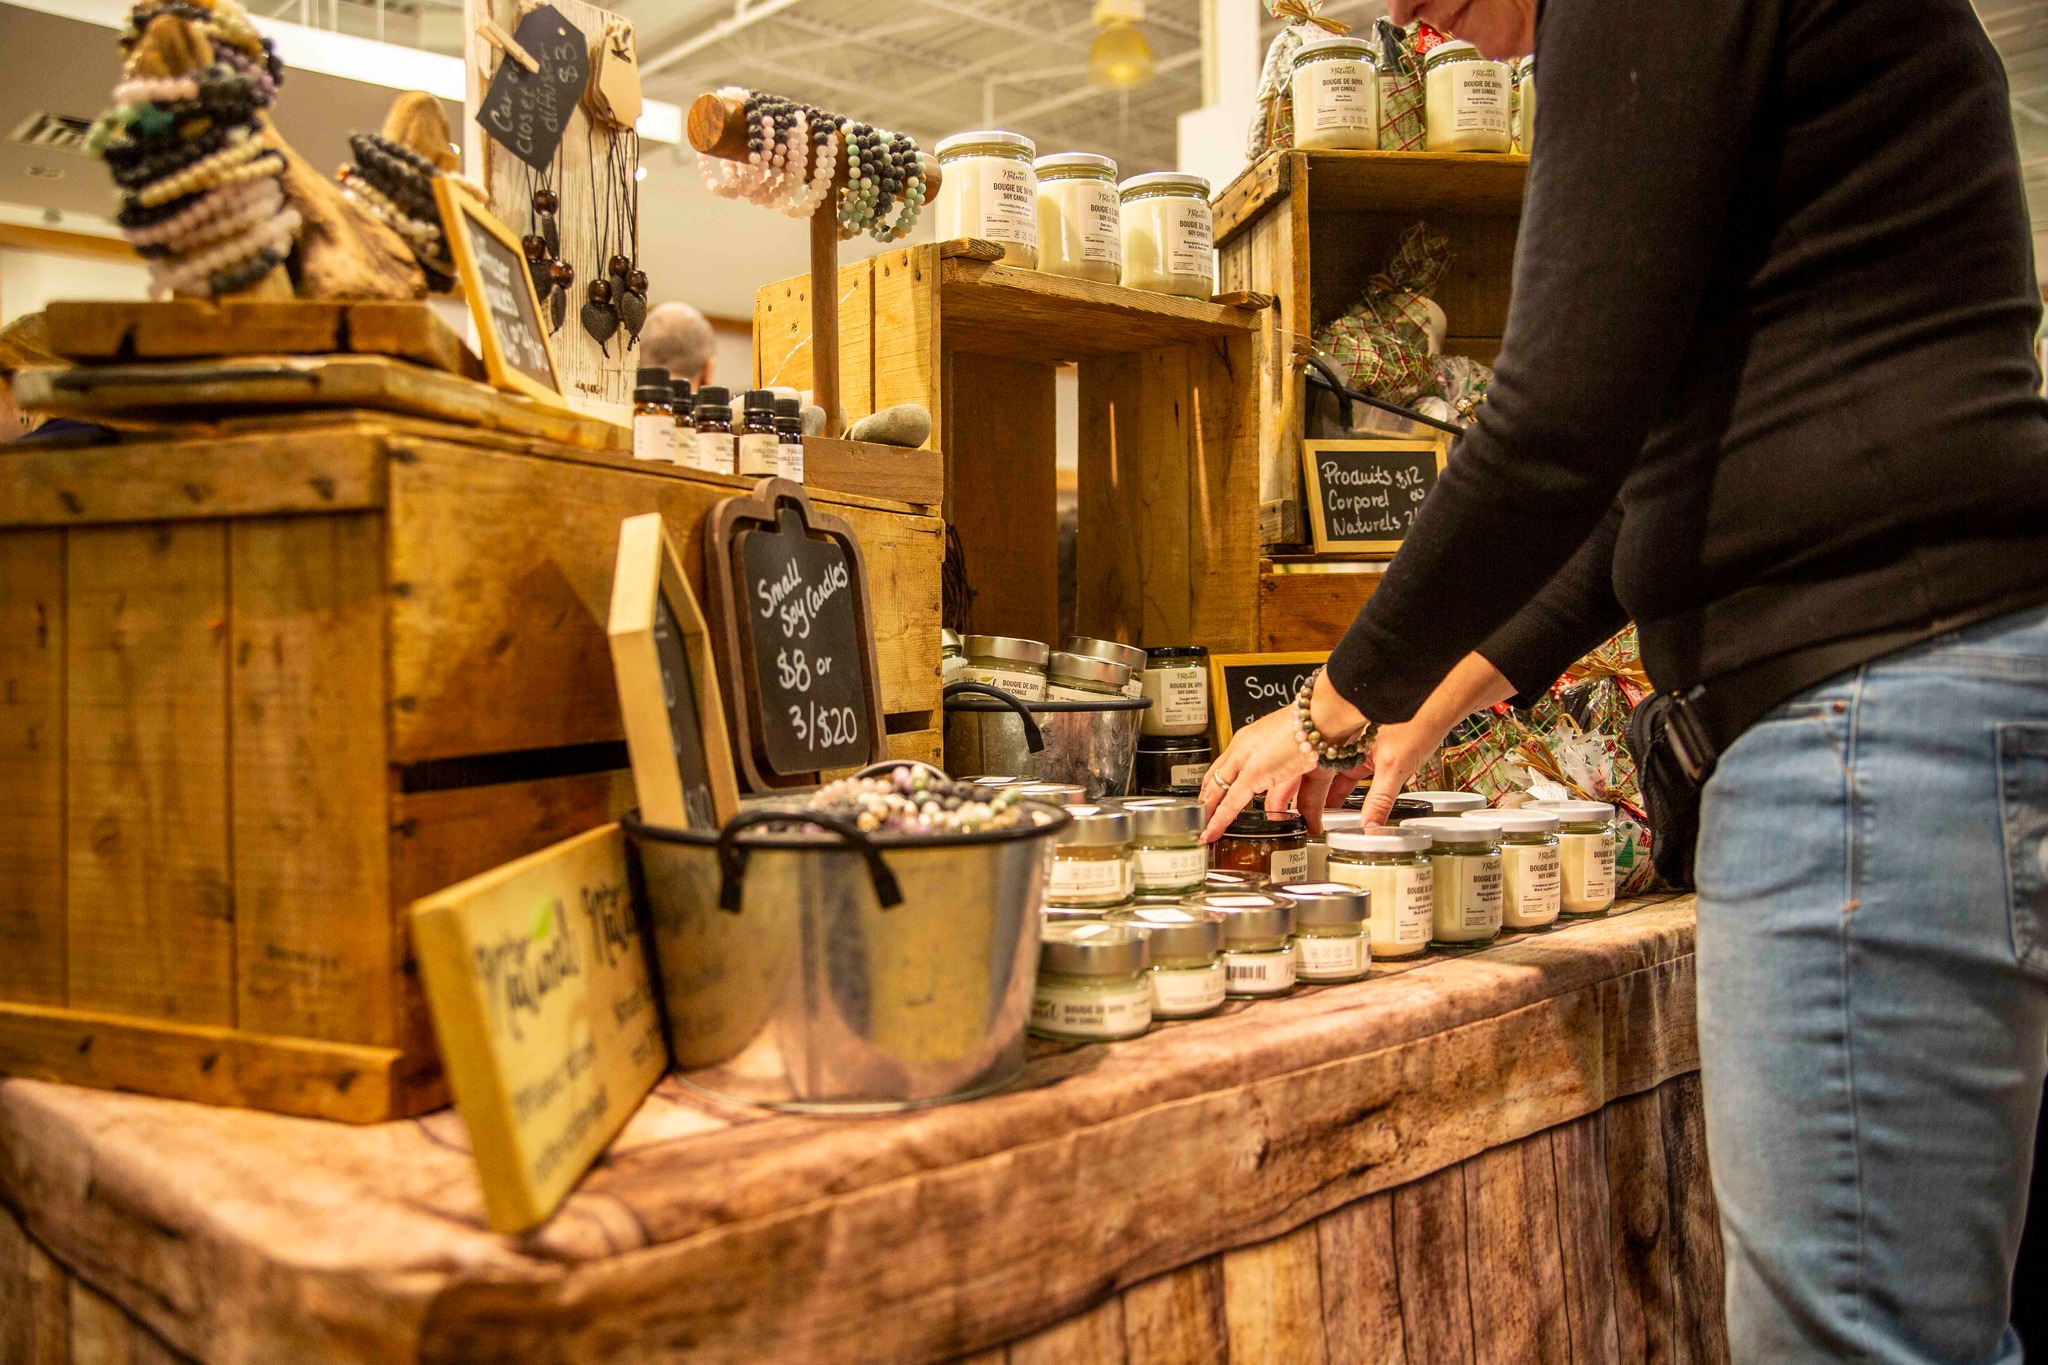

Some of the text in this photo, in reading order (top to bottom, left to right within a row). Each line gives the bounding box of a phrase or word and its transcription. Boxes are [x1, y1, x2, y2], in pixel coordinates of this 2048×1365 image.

[1323, 78, 1342, 86] BOUGIE
[490, 90, 513, 133] Car
[993, 183, 1015, 193] BOUGIE
[1016, 185, 1023, 193] DE
[1013, 194, 1028, 203] CANDLE
[1091, 204, 1108, 214] BOUGIE
[1180, 220, 1198, 229] BOUGIE
[1199, 222, 1204, 230] DE
[1321, 461, 1424, 489] Produits $12
[1333, 511, 1401, 536] Naturels
[757, 557, 803, 619] Small
[777, 647, 832, 692] $8 or
[1003, 679, 1022, 688] BOUGIE
[1245, 676, 1290, 707] Soy
[789, 700, 858, 751] 3/$20
[1282, 867, 1298, 875] BOUGIE
[1530, 864, 1547, 872] BOUGIE
[1473, 874, 1491, 883] BOUGIE
[1407, 886, 1424, 895] BOUGIE
